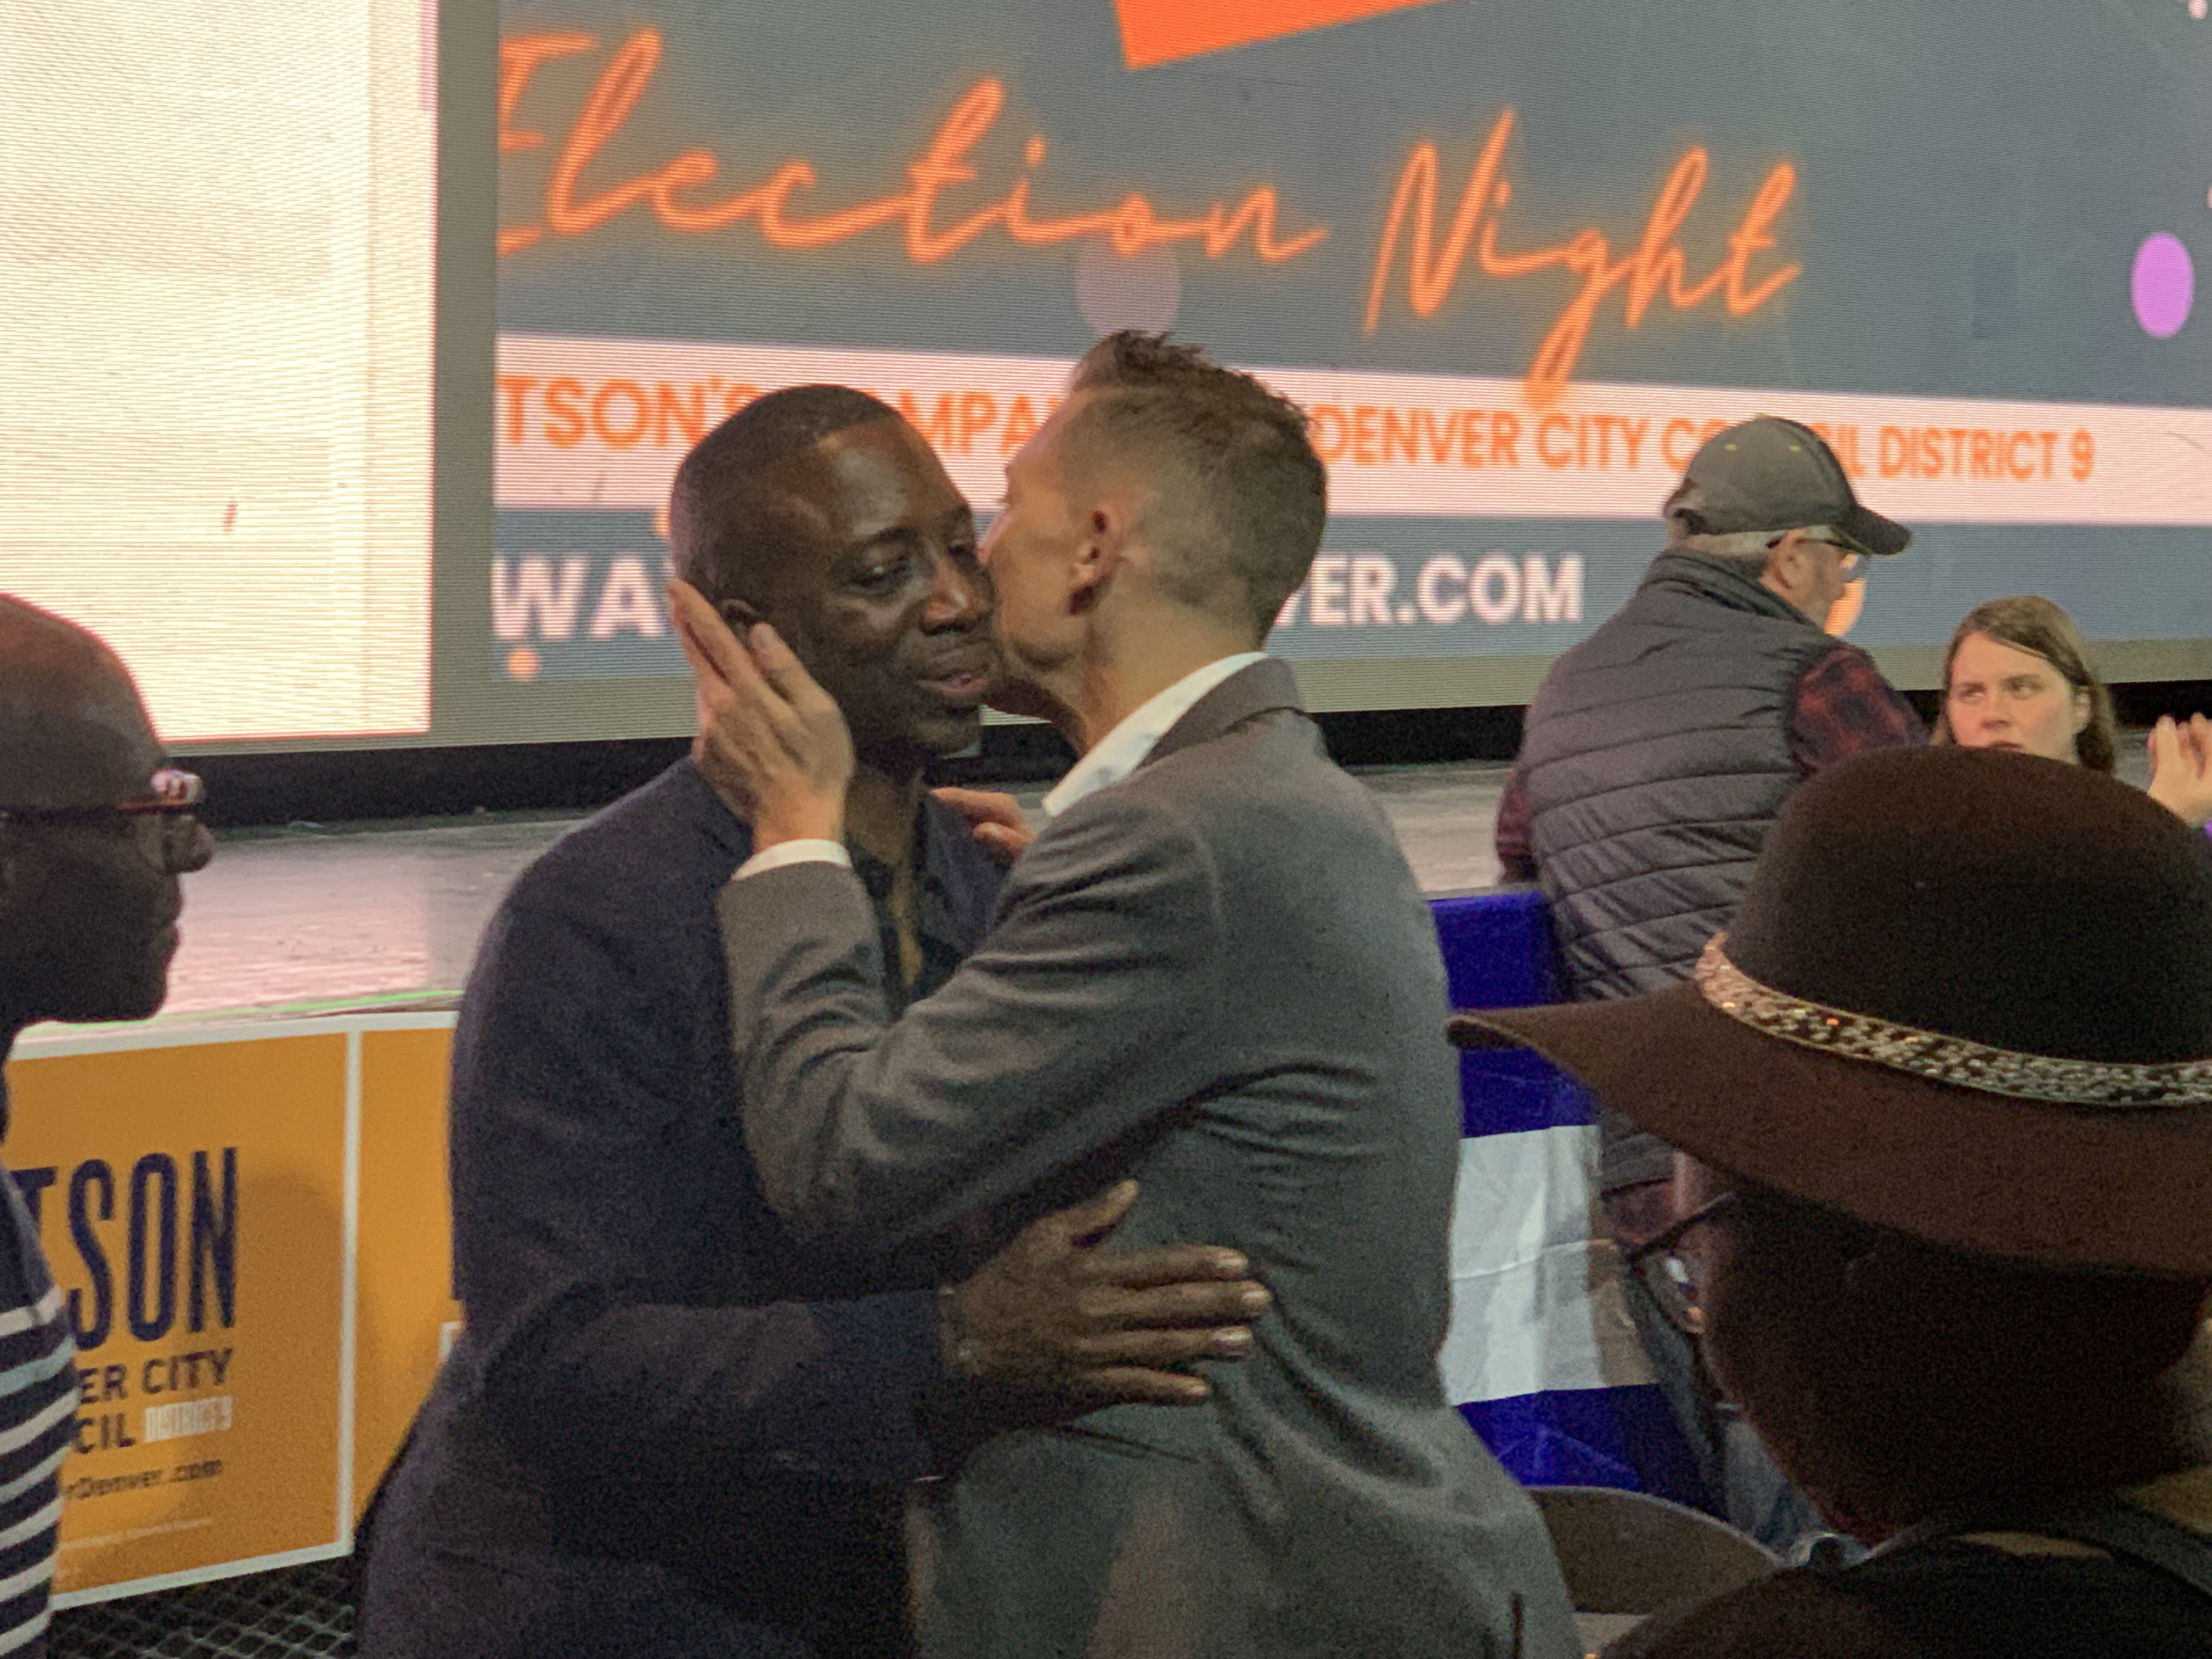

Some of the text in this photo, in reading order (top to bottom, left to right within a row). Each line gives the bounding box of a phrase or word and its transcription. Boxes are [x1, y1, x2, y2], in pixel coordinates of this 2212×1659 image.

[498, 25, 1801, 407] Election Night
[1310, 405, 1517, 467] DENVER
[1538, 411, 1648, 471] CITY
[1879, 425, 2059, 481] DISTRICT
[2070, 428, 2095, 481] 9
[492, 553, 675, 639] WA
[142, 1346, 232, 1395] CITY
